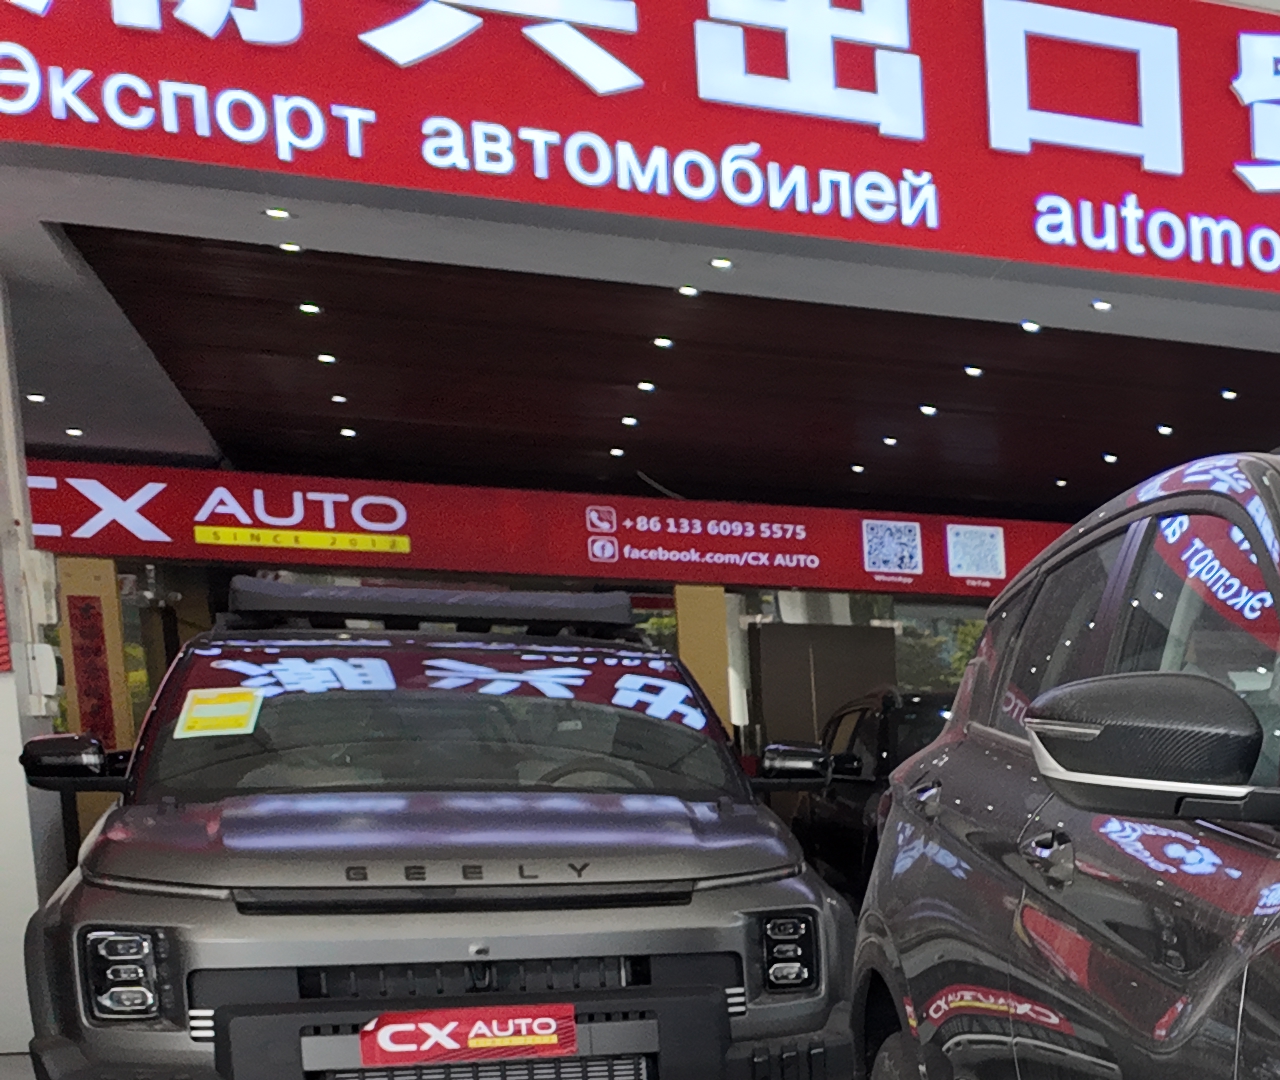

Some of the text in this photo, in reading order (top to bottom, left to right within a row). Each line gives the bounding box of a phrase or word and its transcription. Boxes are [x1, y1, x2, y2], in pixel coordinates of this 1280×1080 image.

[0, 40, 941, 230] Экспорт автомобилей
[194, 486, 408, 532] AUTO
[212, 531, 300, 545] SINCE
[622, 515, 807, 540] +86 133 6093 5575
[623, 545, 820, 569] facebook.com/CX AUTO
[345, 863, 591, 881] GEELY
[377, 1021, 460, 1052] CX
[468, 1017, 557, 1038] AUTO
